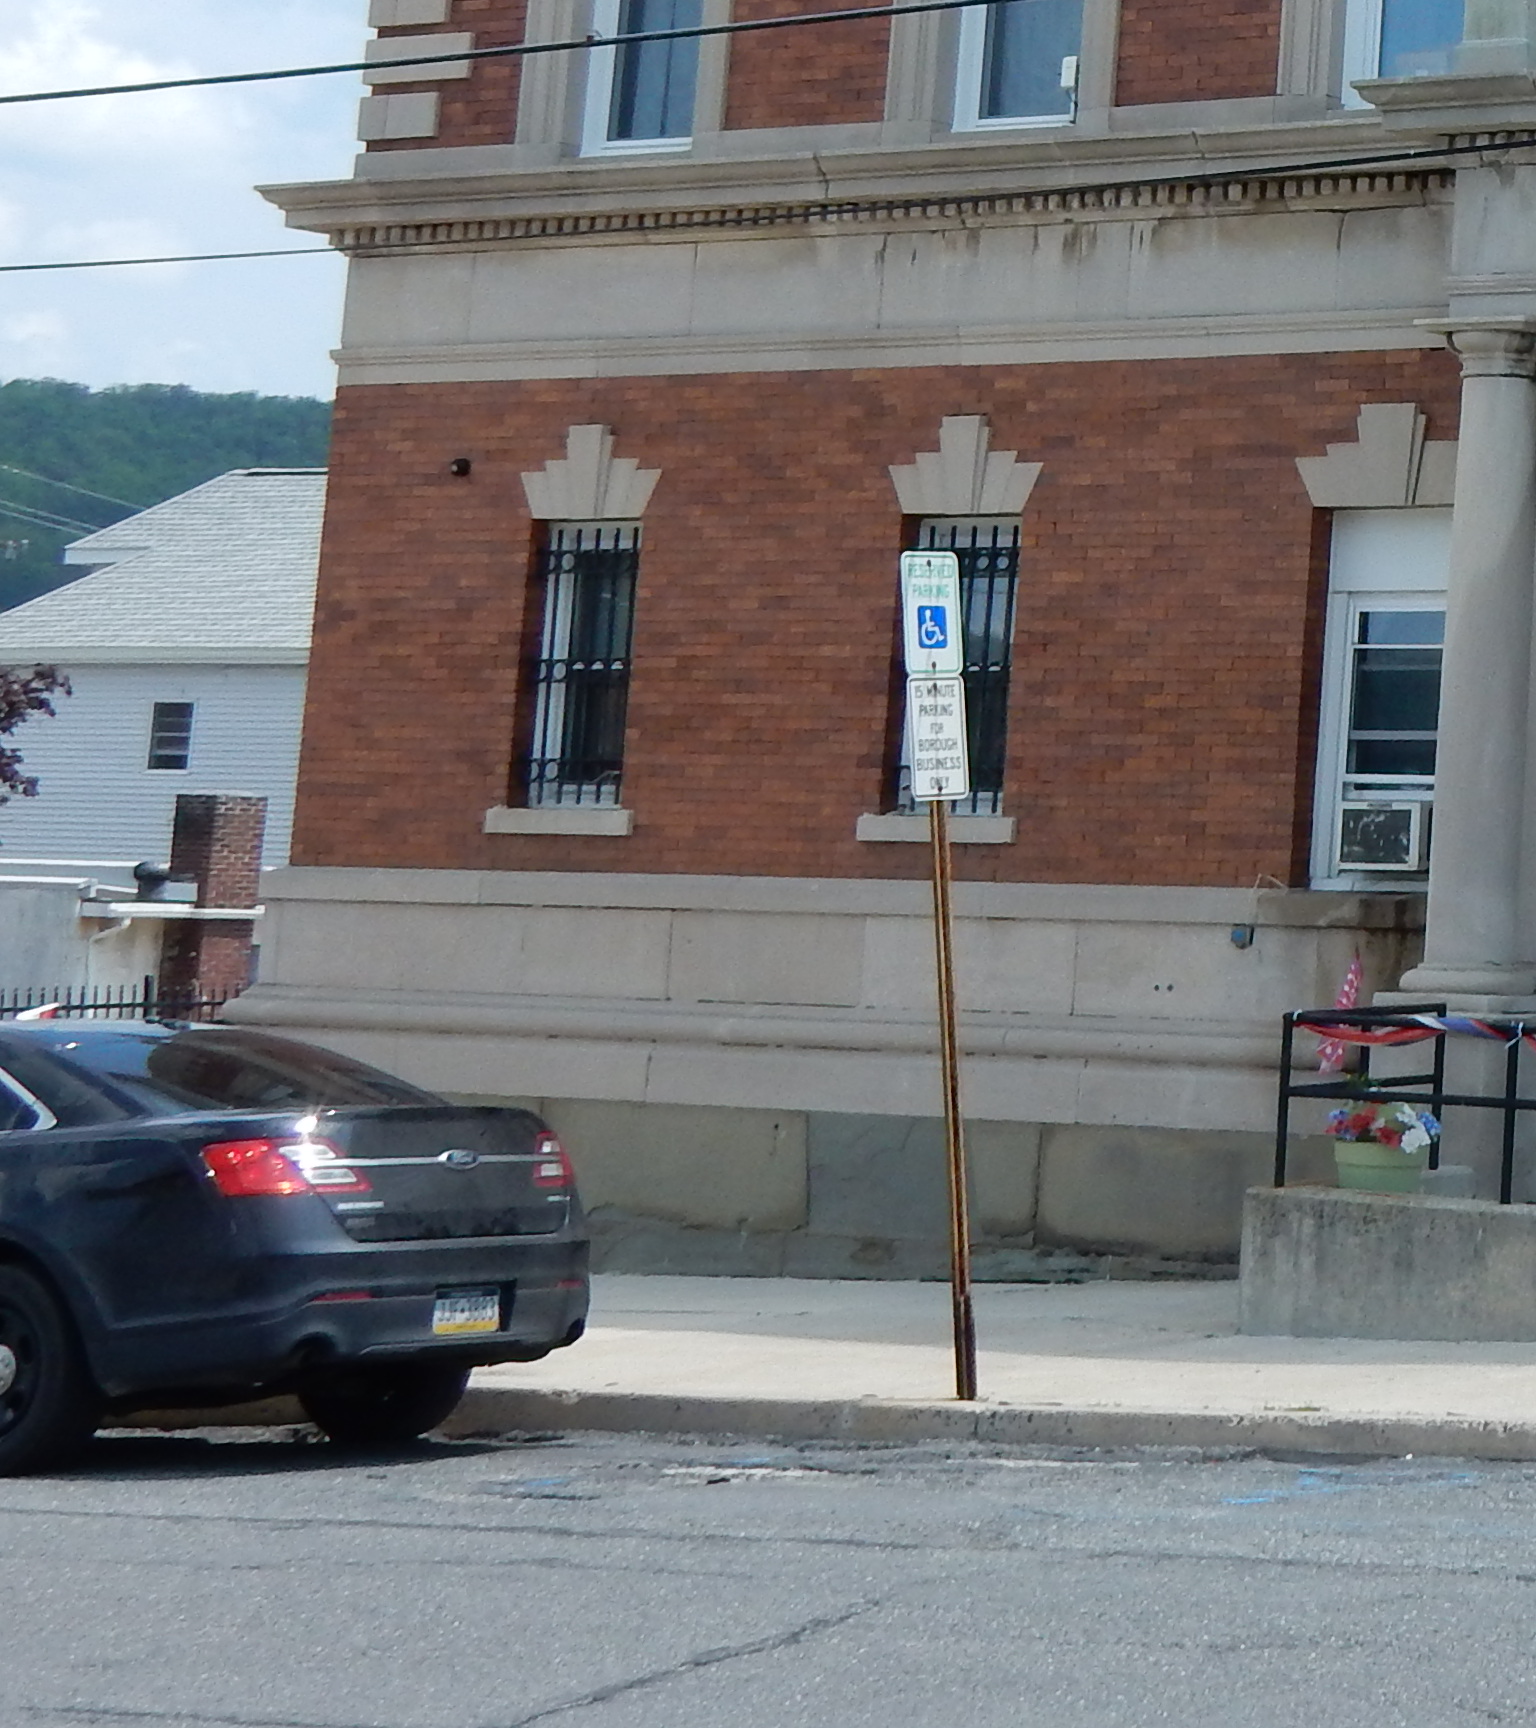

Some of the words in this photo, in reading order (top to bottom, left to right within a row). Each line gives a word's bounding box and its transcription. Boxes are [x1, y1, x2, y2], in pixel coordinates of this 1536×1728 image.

[912, 583, 950, 599] PARKING
[918, 703, 954, 718] PARKING
[918, 737, 958, 753] BOROUGH
[916, 755, 962, 772] BUSINESS
